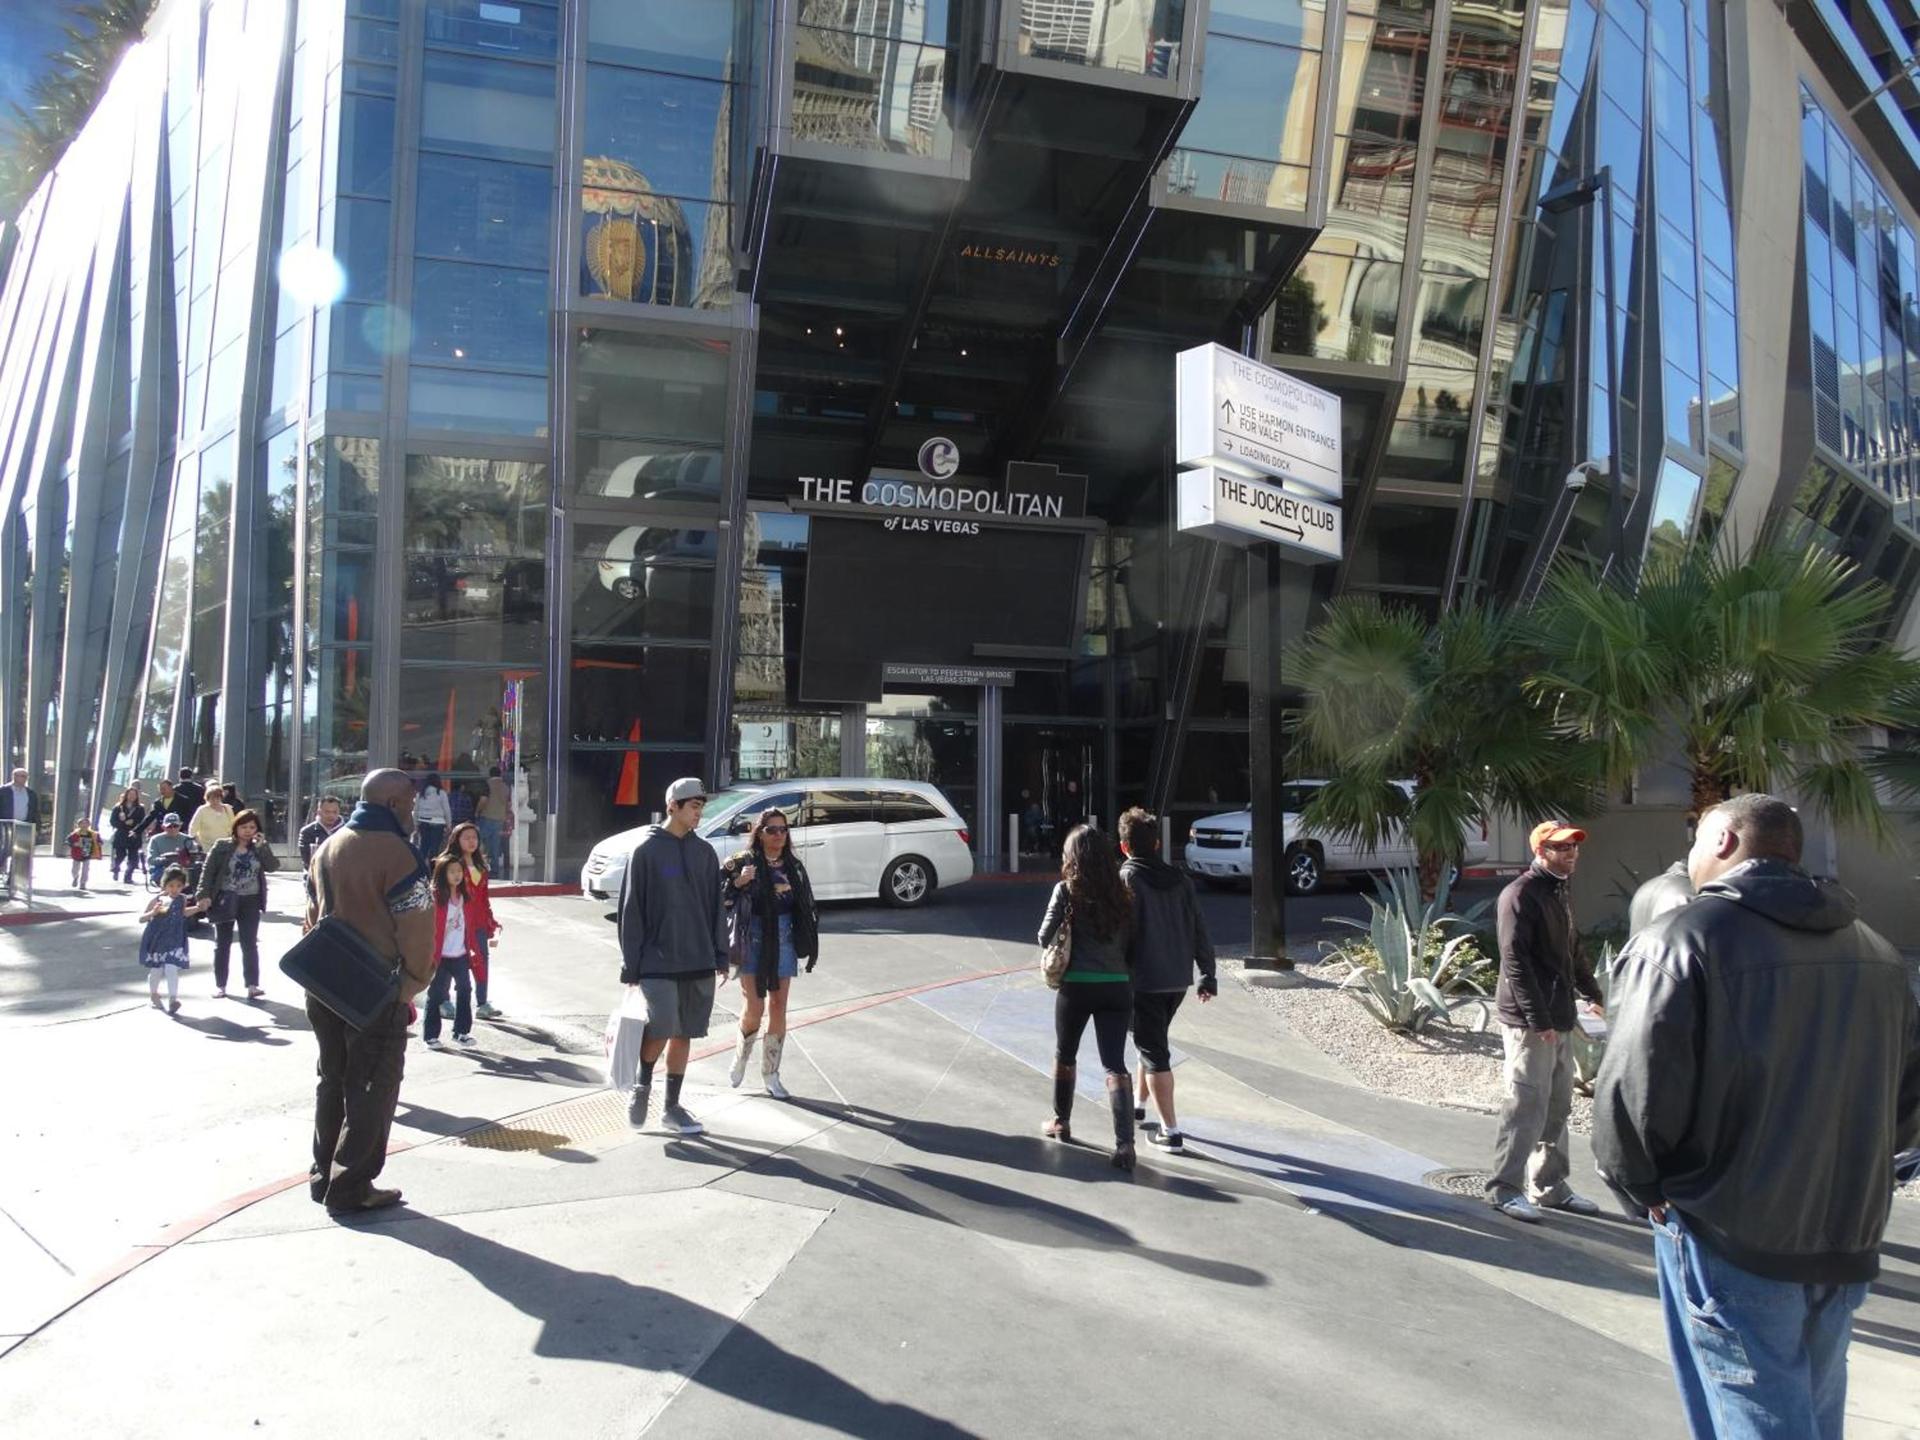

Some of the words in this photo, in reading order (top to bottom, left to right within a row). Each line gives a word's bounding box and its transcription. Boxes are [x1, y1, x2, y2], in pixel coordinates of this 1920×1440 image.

[961, 245, 1061, 267] ALLSAINTS
[1232, 361, 1251, 381] THE
[1255, 371, 1326, 413] COSMOPOLITAN
[1240, 404, 1256, 420] USE
[1259, 410, 1294, 434] HARMON
[1295, 425, 1336, 450] ENTRANCE
[1240, 418, 1256, 433] FOR
[1259, 425, 1283, 443] VALET
[1240, 445, 1270, 466] LOADING
[1272, 454, 1291, 472] DOCK
[798, 477, 853, 503] THE
[862, 482, 1063, 518] COSMOPOLITAN
[1219, 477, 1248, 504] THE
[1250, 488, 1300, 521] JOCKEY
[1301, 505, 1335, 532] CLUB
[884, 516, 899, 530] of
[902, 518, 929, 531] LAS
[934, 519, 980, 534] VEGAS
[887, 666, 929, 676] ESCALATOR
[940, 669, 984, 678] PEDESTRIAN
